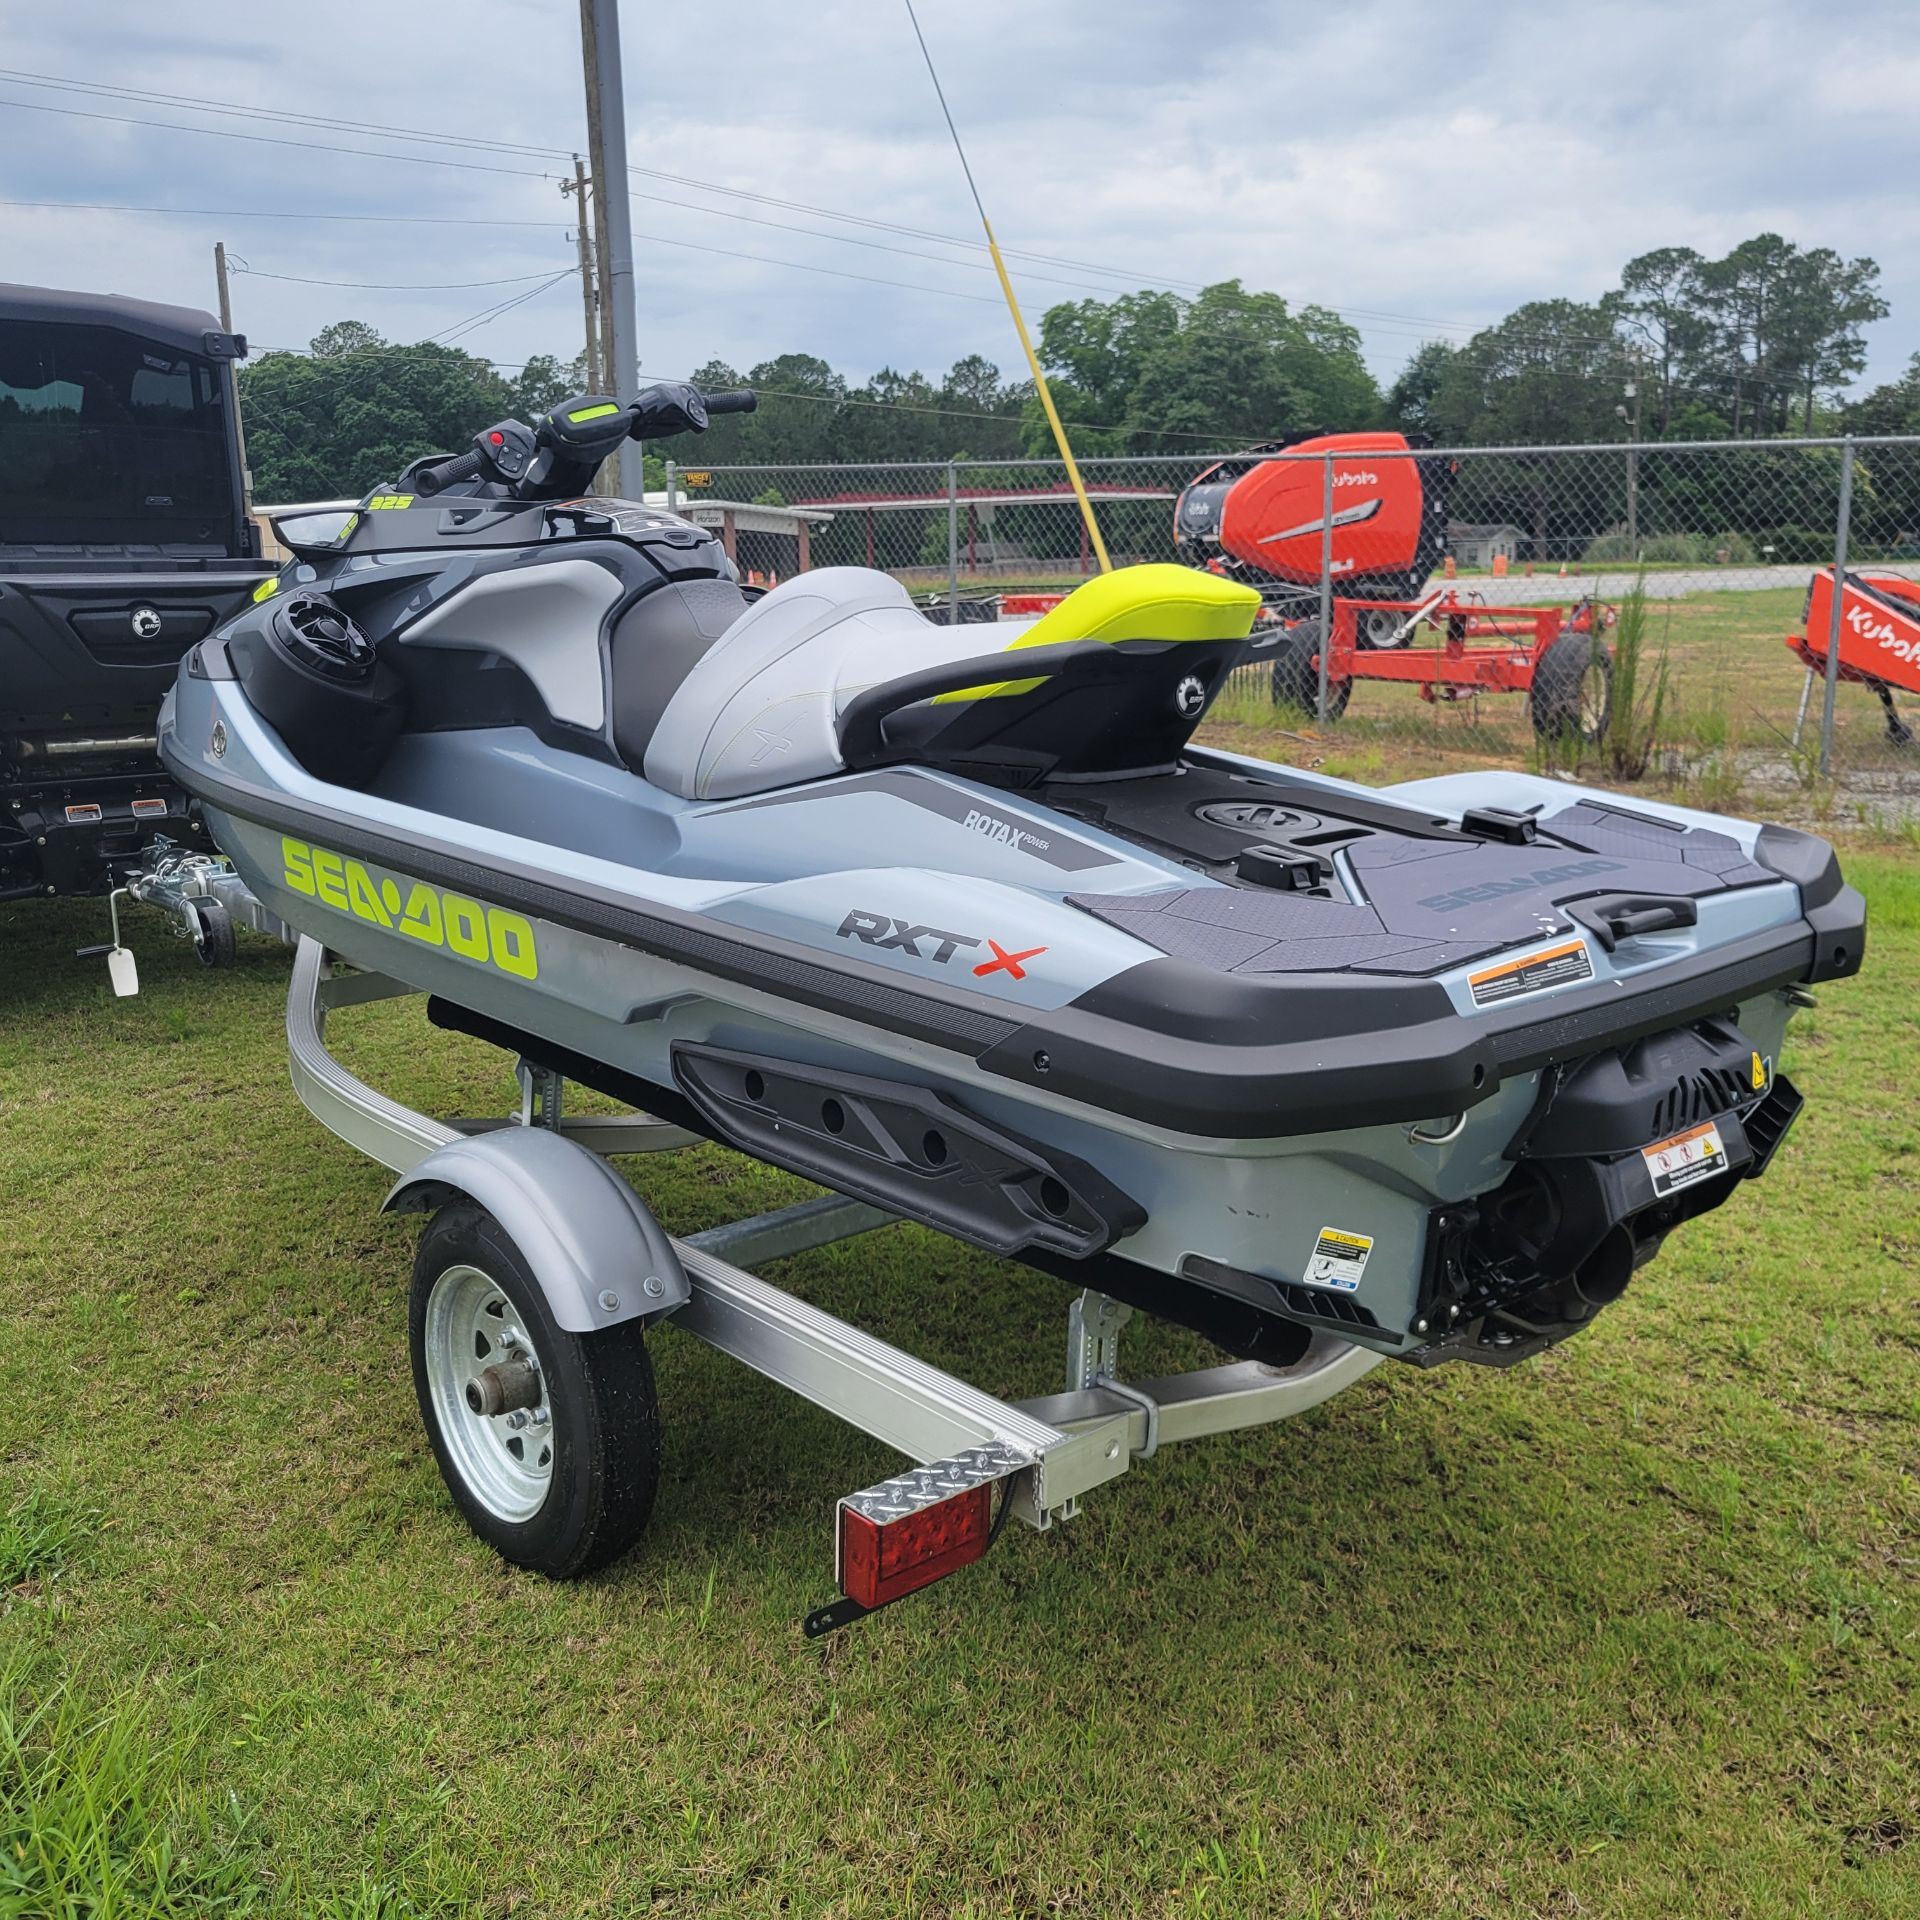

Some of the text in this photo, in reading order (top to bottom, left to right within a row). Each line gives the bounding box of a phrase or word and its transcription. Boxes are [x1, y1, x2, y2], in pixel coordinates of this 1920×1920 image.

[368, 496, 414, 510] 325
[962, 809, 1050, 851] ROTAX POWER
[835, 908, 1050, 981] RXT X
